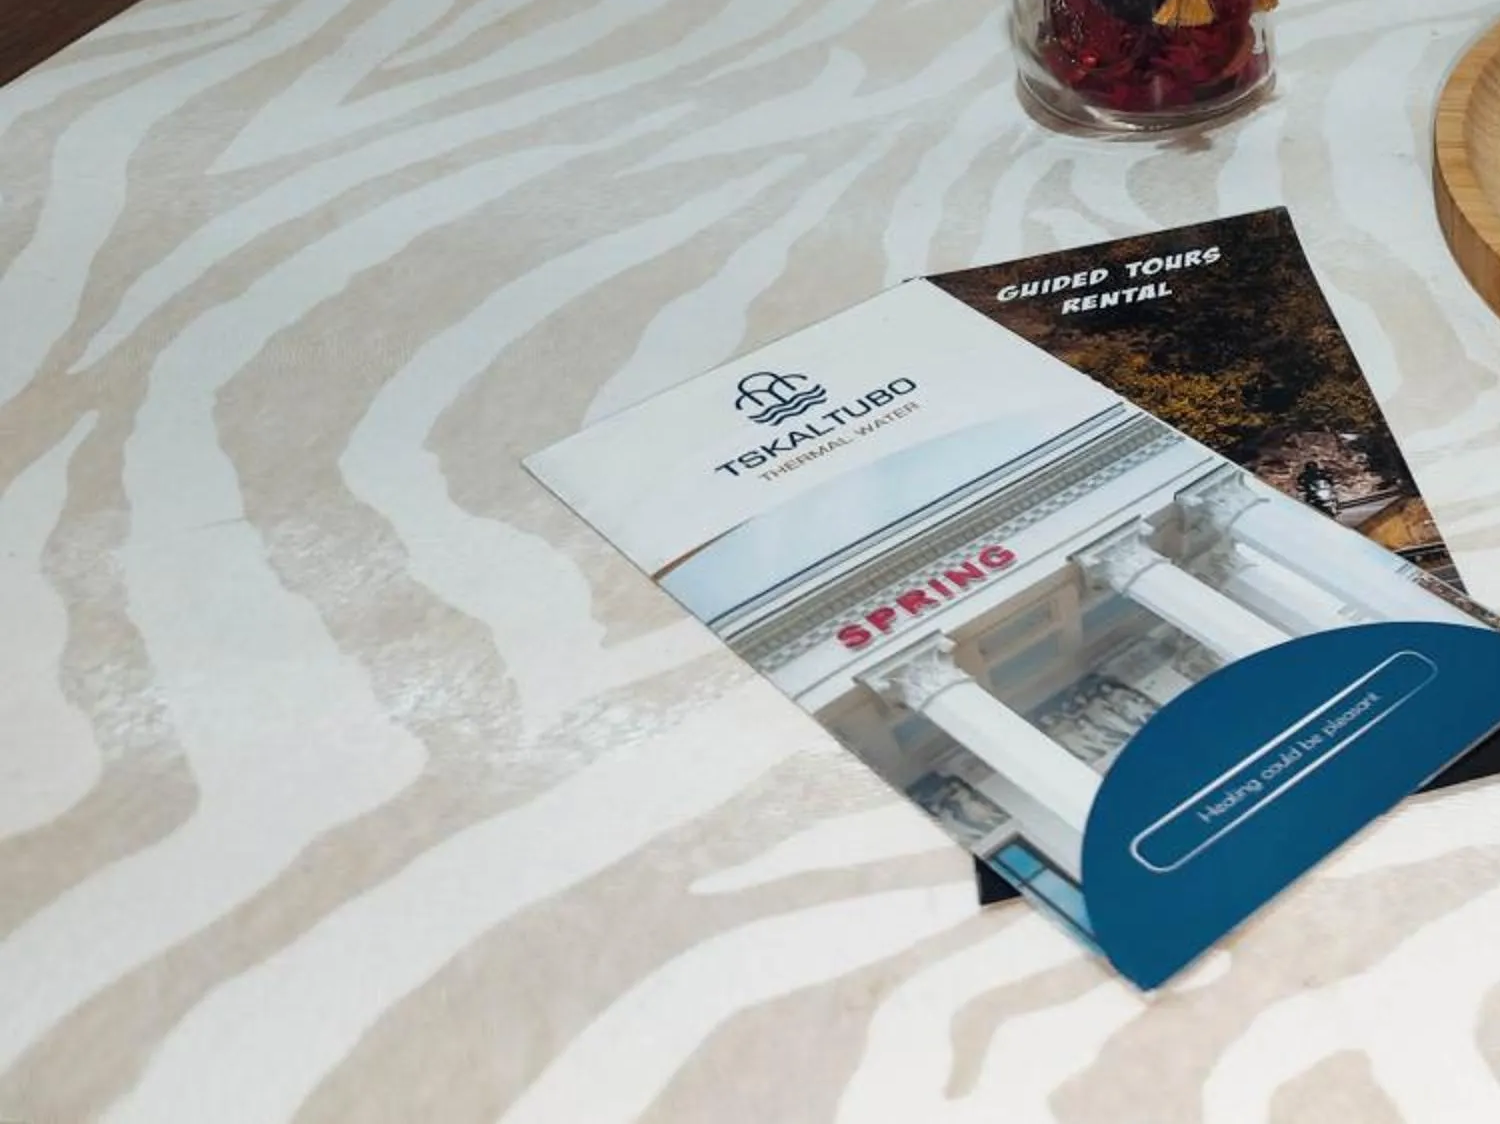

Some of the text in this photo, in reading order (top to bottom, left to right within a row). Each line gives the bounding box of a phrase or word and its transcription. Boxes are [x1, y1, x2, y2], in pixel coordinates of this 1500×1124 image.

[996, 246, 1222, 303] GUIDED TOURS
[1061, 281, 1173, 315] RENTAL
[714, 376, 918, 477] TSKALTUBO
[758, 400, 920, 482] THERMAL WATER
[836, 545, 1018, 651] SPRING
[1197, 690, 1383, 824] Healing could be pleasant
